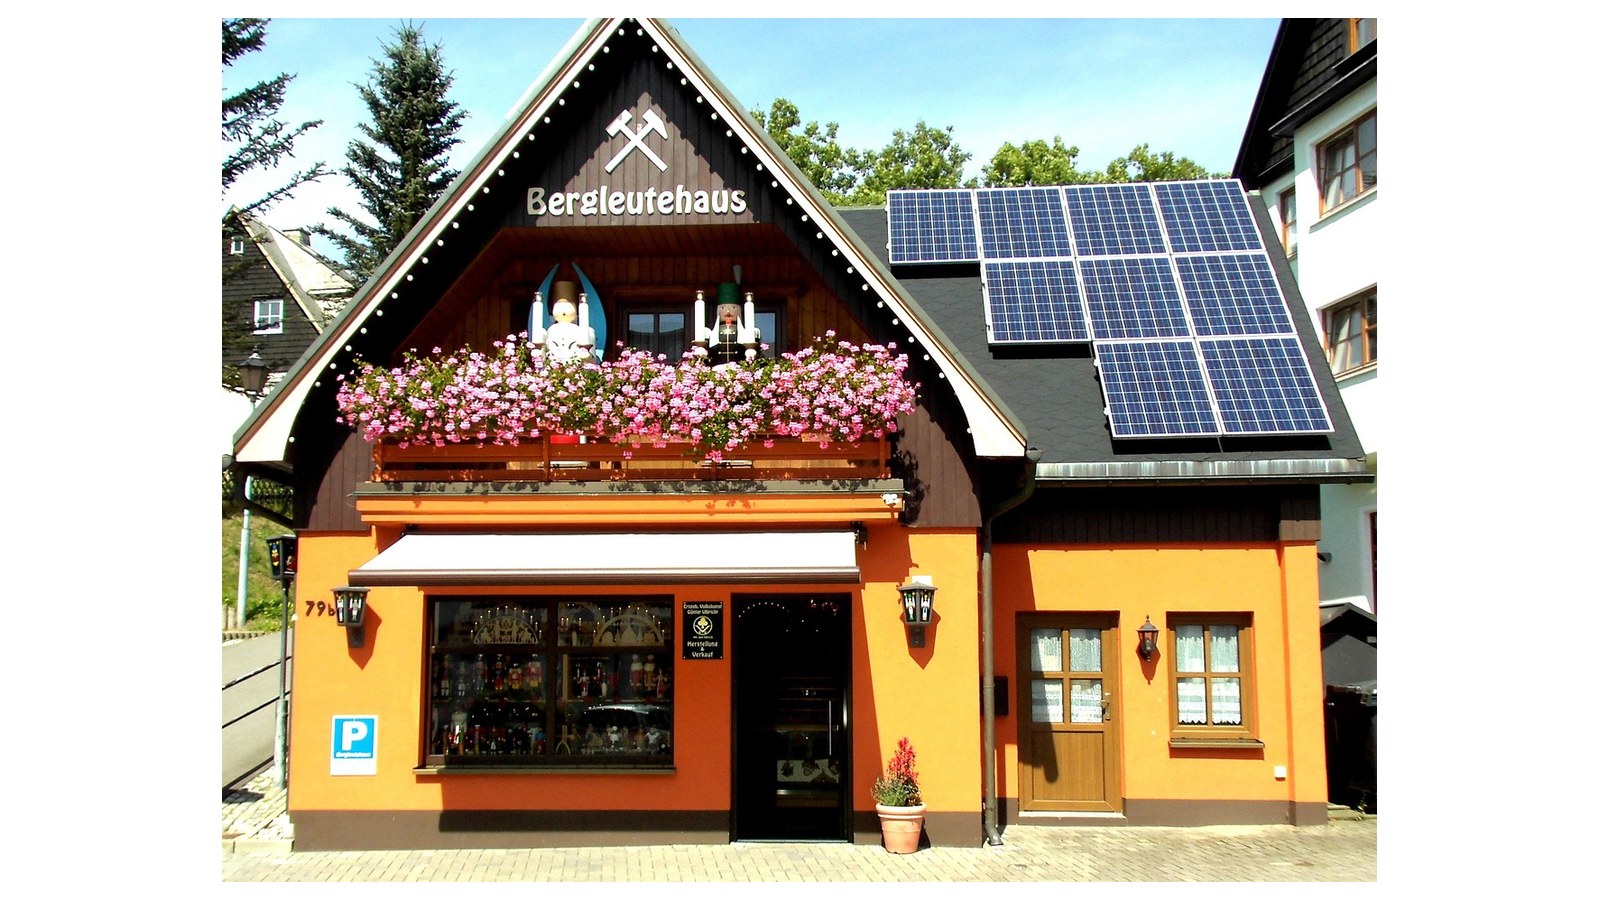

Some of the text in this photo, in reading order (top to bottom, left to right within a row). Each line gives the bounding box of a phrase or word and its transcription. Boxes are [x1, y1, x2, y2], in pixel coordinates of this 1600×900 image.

[527, 185, 747, 216] Bergleutehaus
[305, 600, 336, 617] 79b
[341, 720, 368, 751] P
